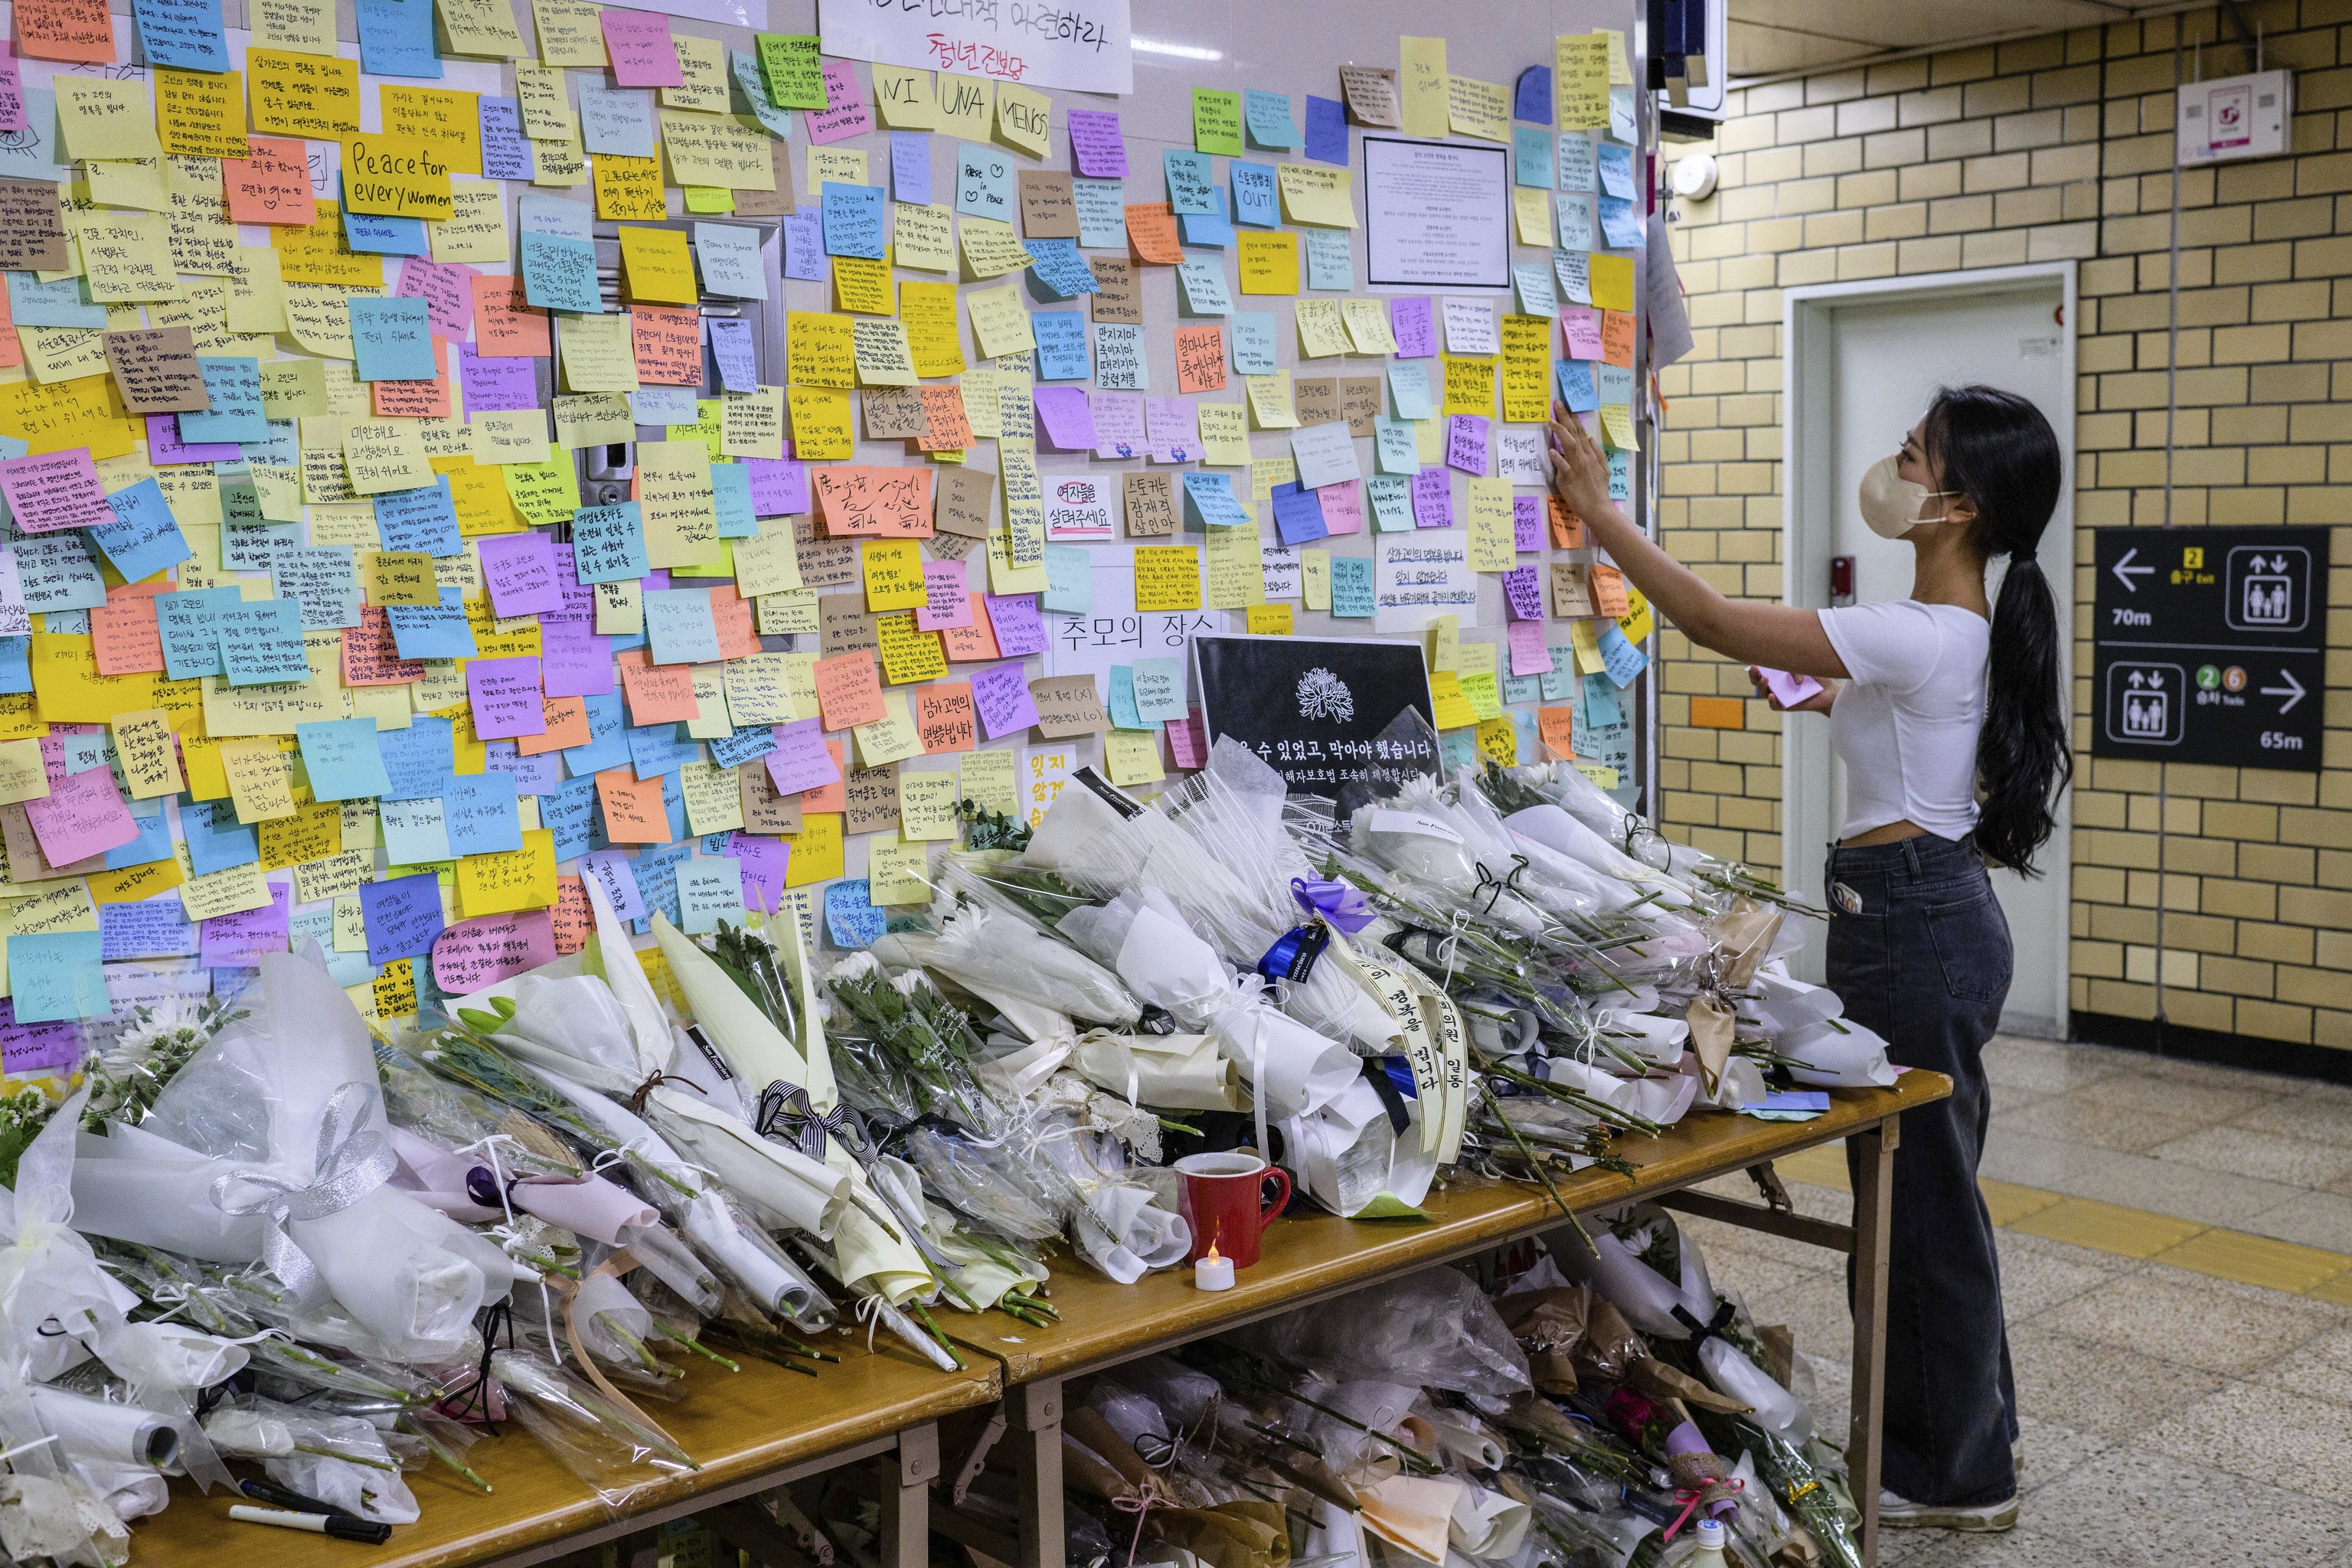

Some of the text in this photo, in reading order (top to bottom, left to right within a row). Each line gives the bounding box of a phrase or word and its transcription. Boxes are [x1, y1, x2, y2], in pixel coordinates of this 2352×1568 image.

[884, 77, 920, 104] NI
[942, 80, 985, 119] UNA
[1003, 96, 1048, 142] MENOS
[352, 142, 448, 176] Peace for
[965, 164, 983, 178] Rest
[980, 181, 987, 191] in
[354, 183, 451, 211] every women
[986, 193, 1004, 205] Peace
[1243, 190, 1273, 211] OUT!
[1057, 482, 1096, 504] 여자들을
[1128, 476, 1168, 496] 스토커는
[1050, 508, 1111, 529] 살려주세요
[2188, 550, 2197, 567] 2
[2112, 608, 2153, 627] 70m
[1061, 615, 1143, 652] 추모의
[2202, 669, 2241, 689] 2 6
[1256, 740, 1432, 762] 수 있었고, 막아야 했습니다
[2259, 731, 2304, 750] 65m
[1338, 768, 1369, 783] 조속히
[1289, 952, 1307, 981] rancisco
[702, 1044, 730, 1079] San Francisco
